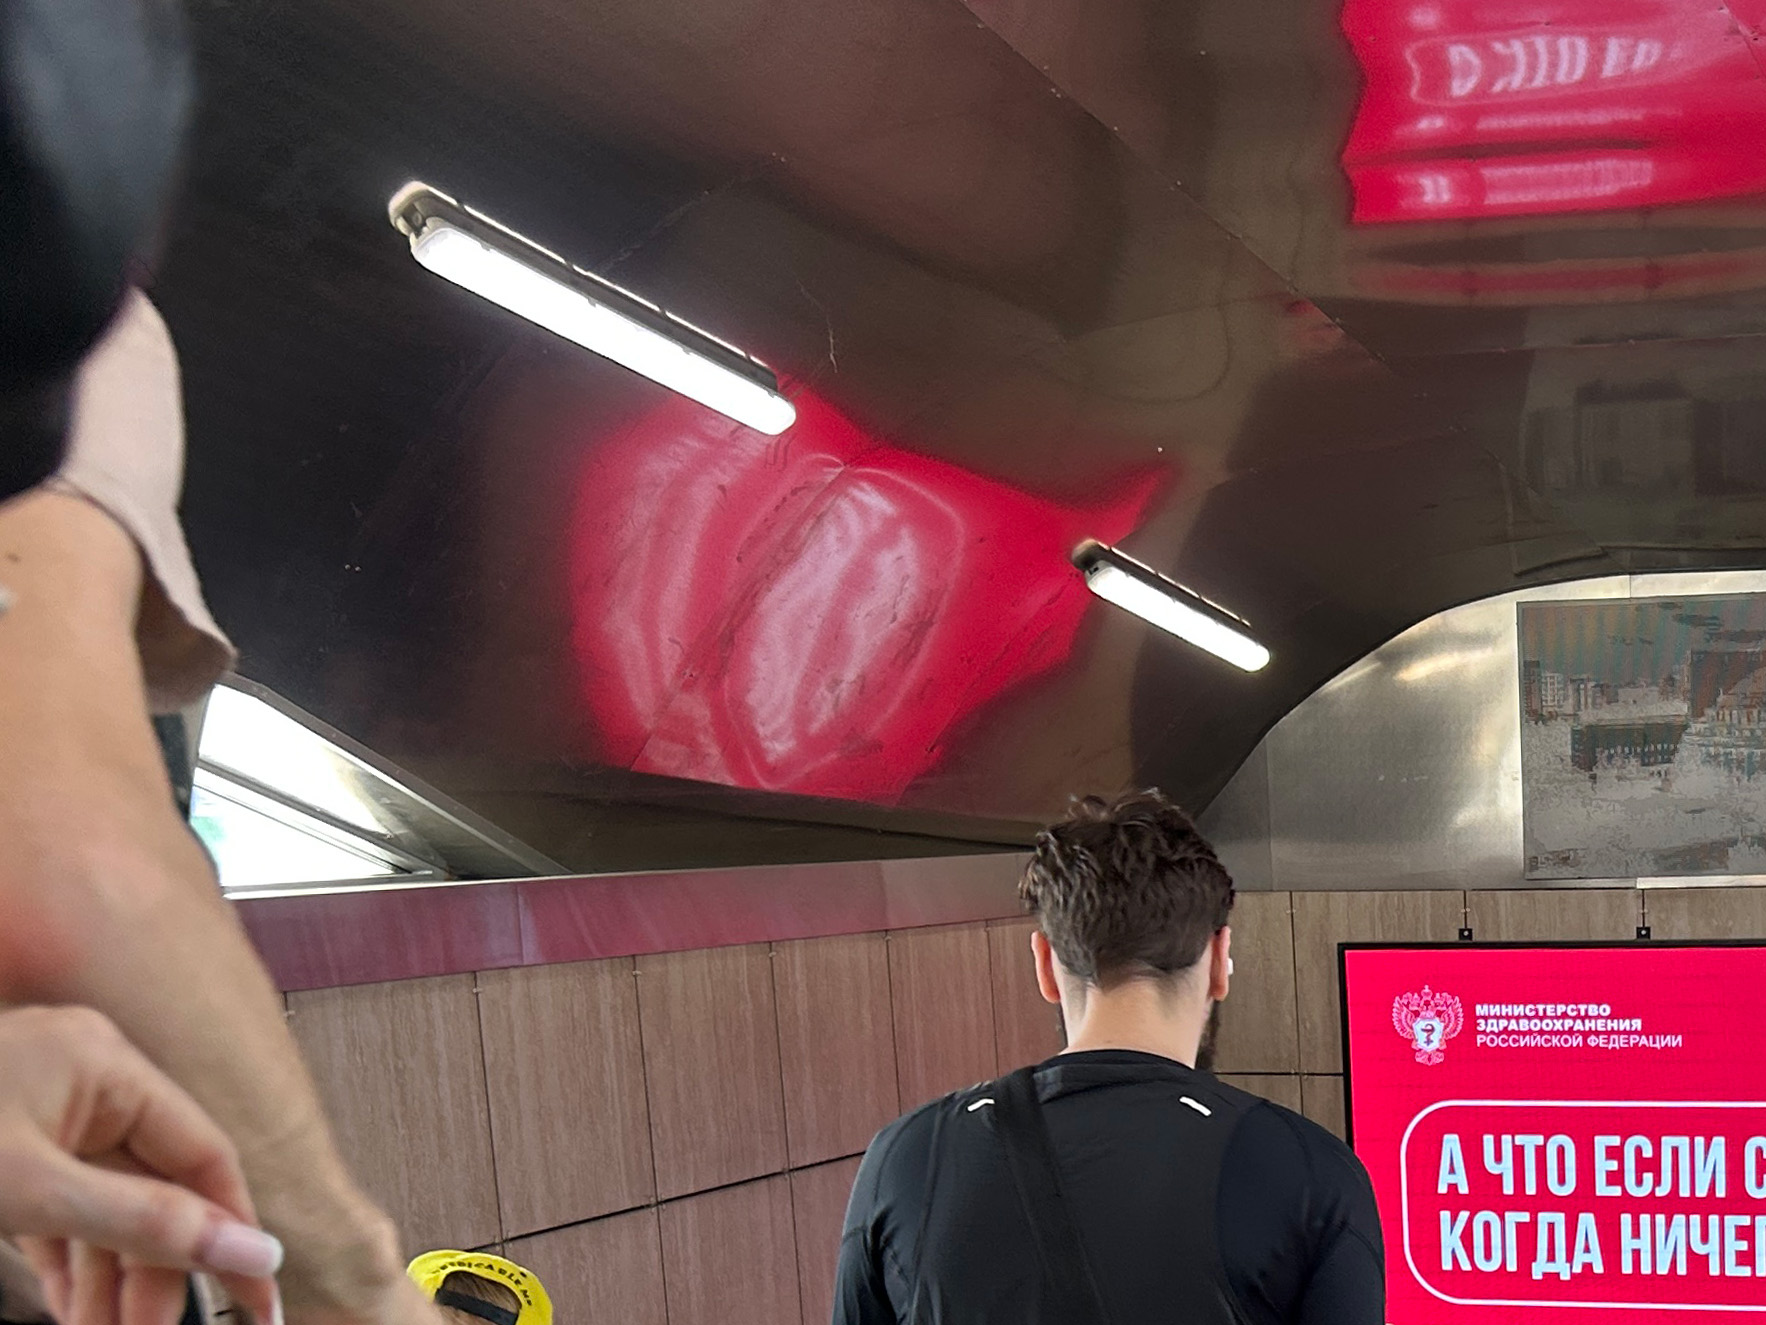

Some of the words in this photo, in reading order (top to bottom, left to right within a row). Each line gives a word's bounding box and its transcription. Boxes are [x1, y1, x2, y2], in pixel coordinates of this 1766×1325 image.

[1476, 1004, 1610, 1016] МИНИСТЕРСТВО
[1477, 1019, 1641, 1033] ЗДРАВООХРАНЕНИЯ
[1477, 1032, 1582, 1047] РОССИЙСКОЙ
[1587, 1035, 1682, 1049] ФЕДЕРАЦИИ
[1438, 1134, 1469, 1194] А
[1483, 1134, 1576, 1196] ЧТО
[1594, 1135, 1726, 1197] ЕСЛИ
[1440, 1211, 1604, 1280] КОГДА
